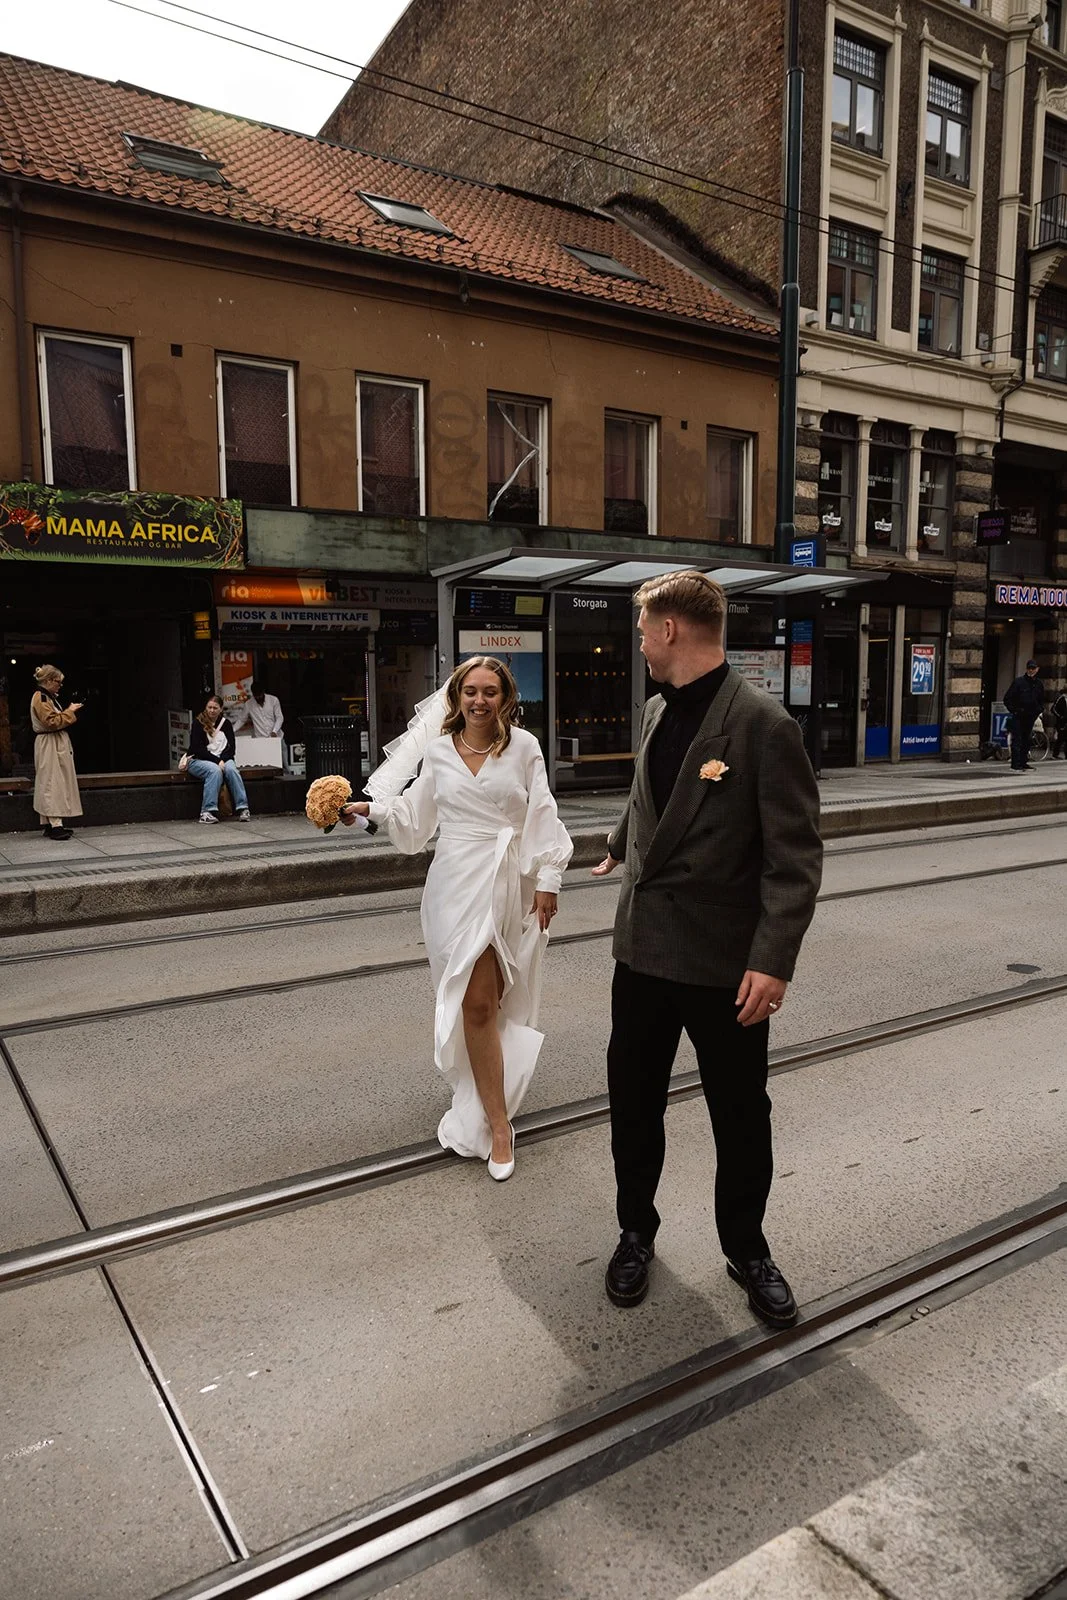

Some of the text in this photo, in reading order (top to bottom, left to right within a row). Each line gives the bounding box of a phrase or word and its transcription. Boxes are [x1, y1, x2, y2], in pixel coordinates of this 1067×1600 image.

[46, 517, 217, 544] MAMA AFRICA
[86, 538, 183, 550] RESTAURANT OG BAR
[221, 579, 249, 599] ria
[996, 584, 1040, 605] REMA
[573, 597, 609, 611] Storgata
[231, 610, 369, 621] KIOSK & INTERNETTKAFE
[480, 636, 522, 646] LINDEX
[221, 650, 248, 663] ria
[913, 661, 925, 682] 29
